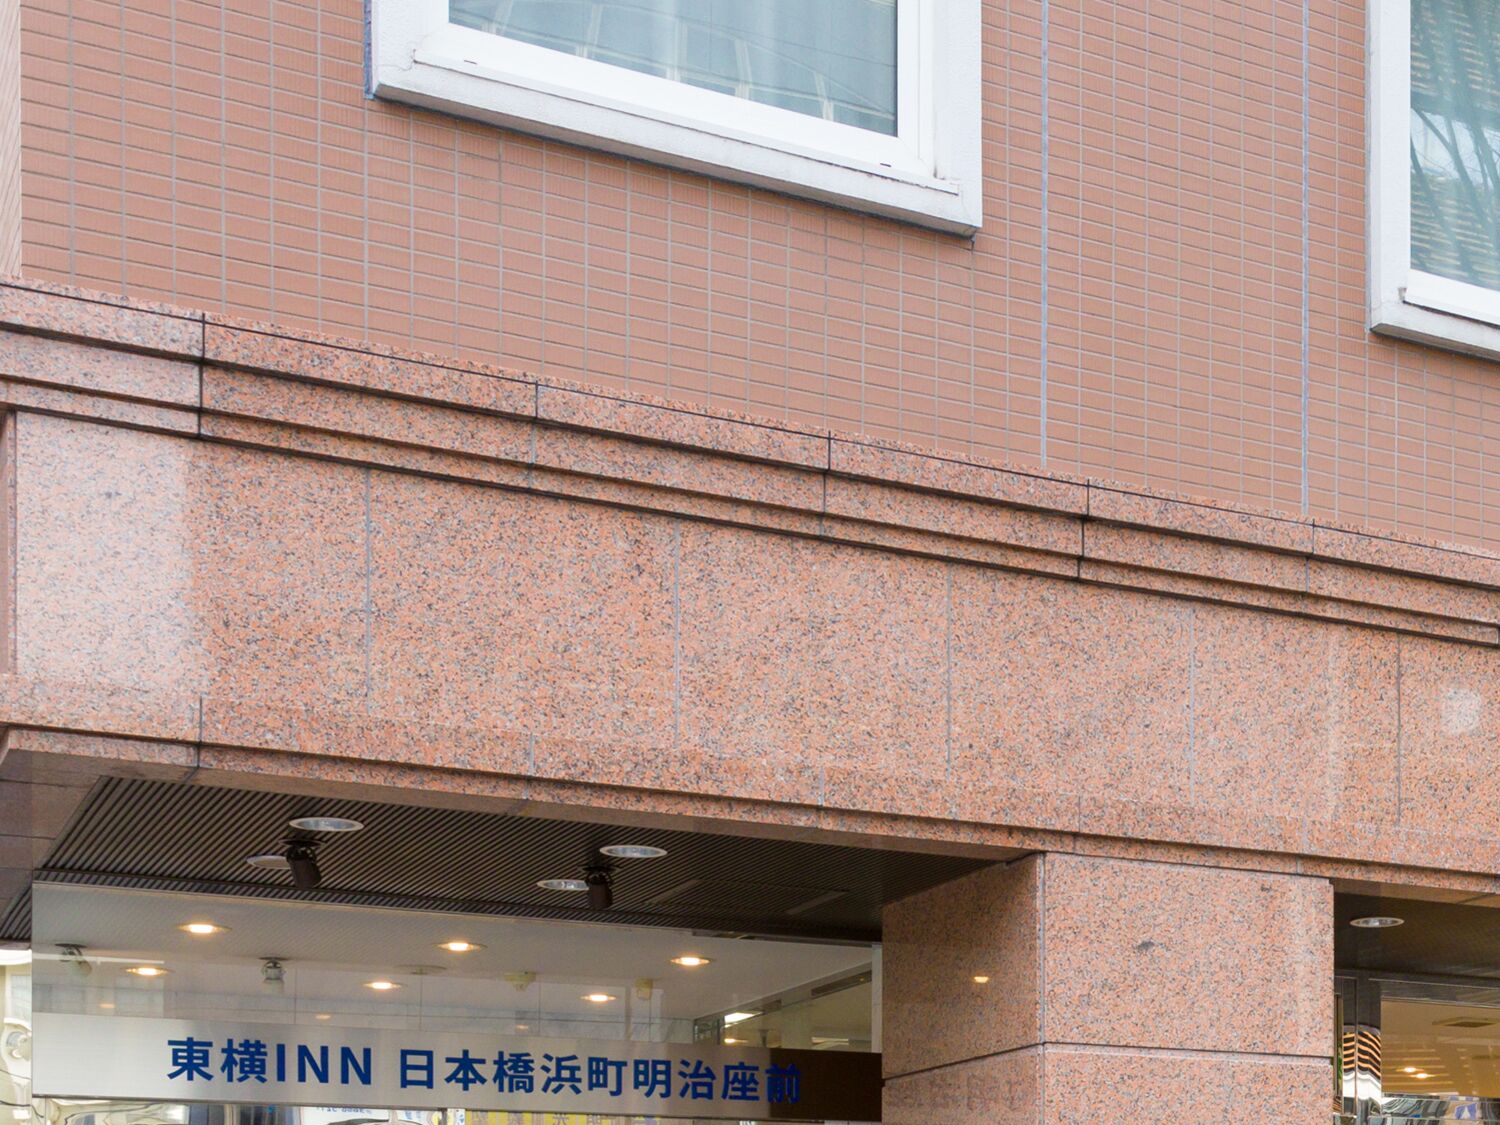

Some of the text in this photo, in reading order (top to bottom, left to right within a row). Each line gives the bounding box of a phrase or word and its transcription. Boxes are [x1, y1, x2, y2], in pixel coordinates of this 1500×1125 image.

[167, 1037, 802, 1104] 東横INN 日本橋浜町明治座前
